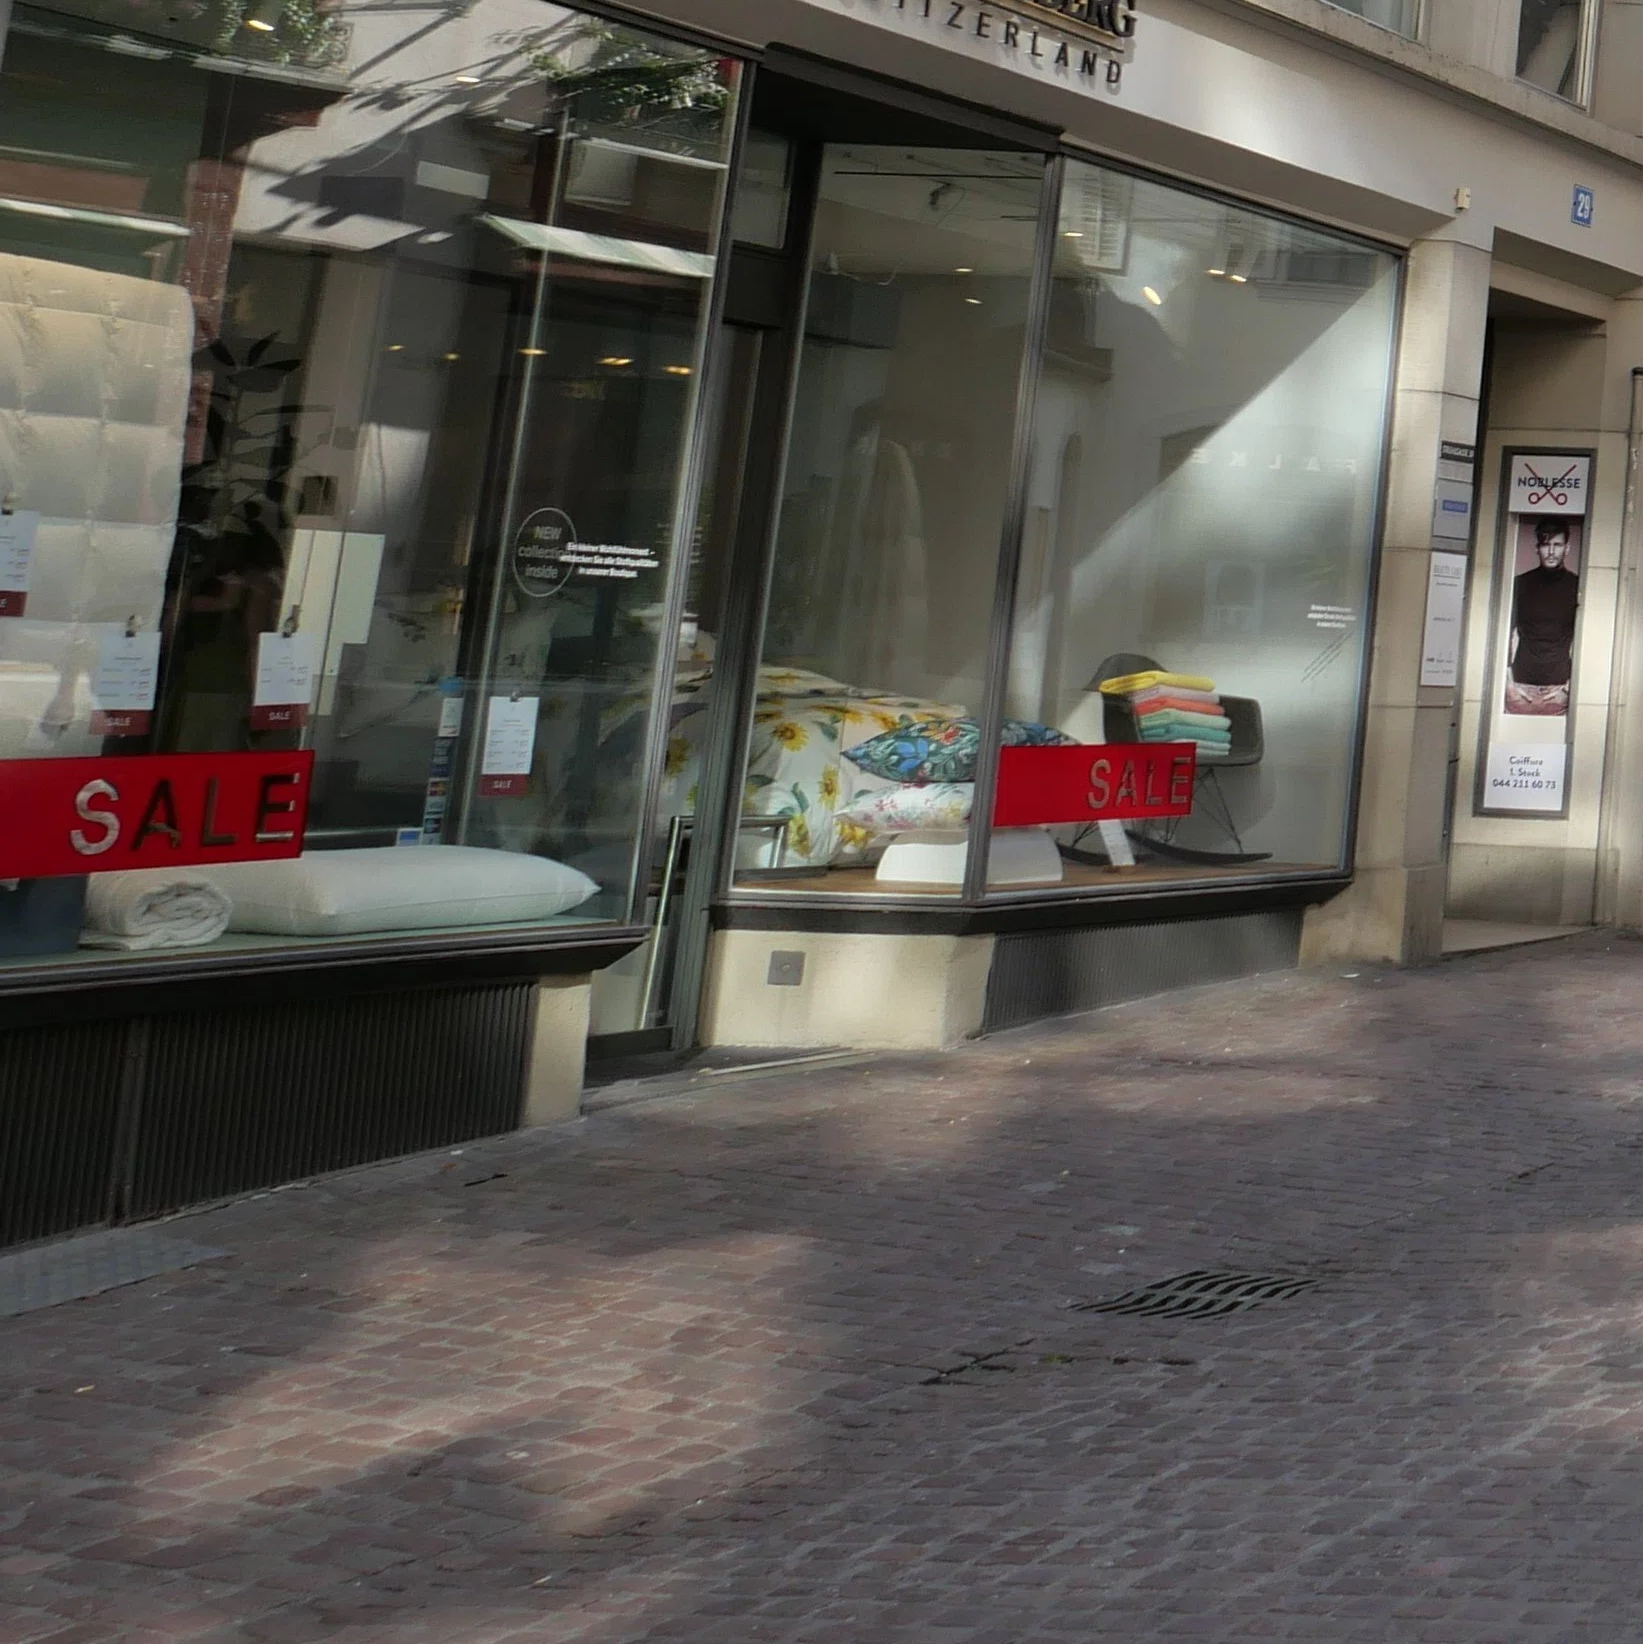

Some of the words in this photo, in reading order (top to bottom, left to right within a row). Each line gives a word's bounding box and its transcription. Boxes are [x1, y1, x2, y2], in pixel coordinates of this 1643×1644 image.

[1577, 192, 1591, 219] 29
[1518, 476, 1581, 489] NOBLESSE
[534, 525, 562, 540] NEW
[525, 564, 559, 579] inside
[1510, 756, 1543, 765] Coiffure
[1518, 767, 1541, 776] Stock
[1087, 757, 1191, 809] SALE
[1492, 778, 1510, 787] 044
[1512, 779, 1529, 788] 211
[70, 772, 300, 855] SALE
